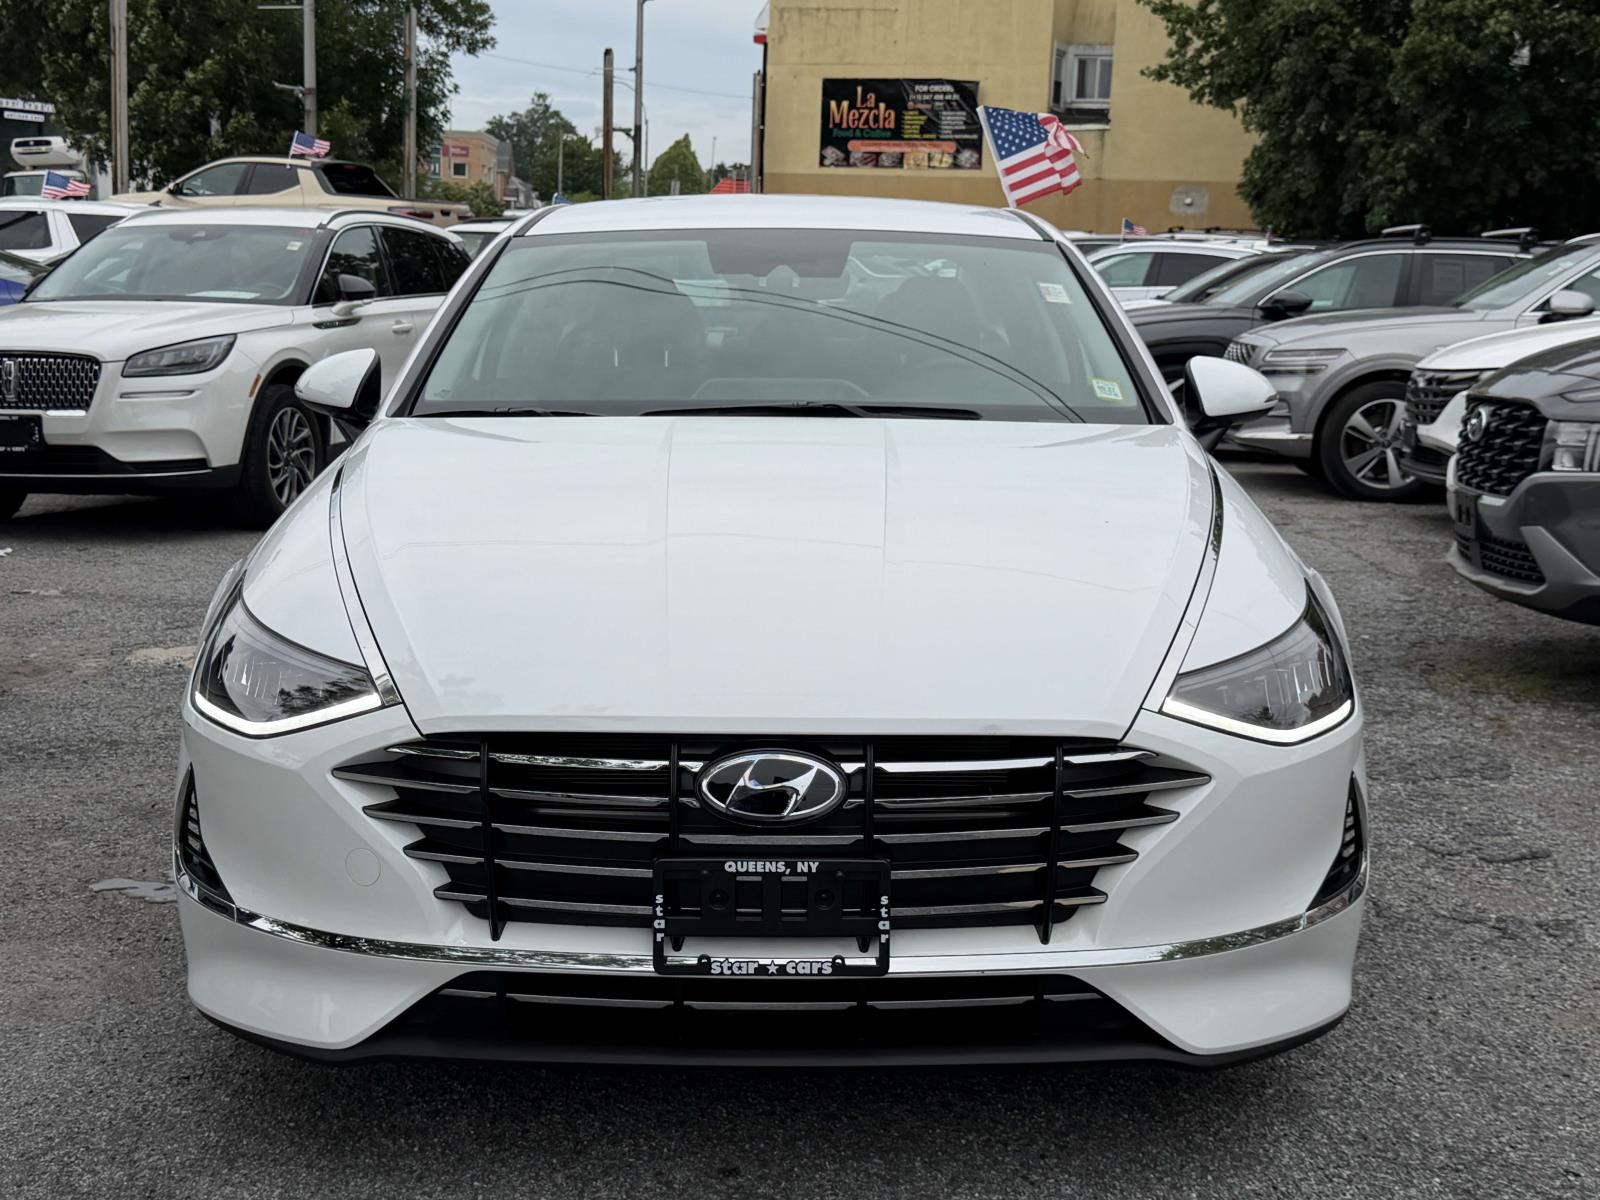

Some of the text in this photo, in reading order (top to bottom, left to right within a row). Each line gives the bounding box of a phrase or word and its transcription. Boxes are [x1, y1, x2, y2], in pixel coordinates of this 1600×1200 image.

[856, 85, 876, 108] La
[829, 100, 896, 129] Mezcla
[833, 128, 854, 138] Food
[854, 129, 862, 138] &
[724, 861, 819, 875] QUEENS, NY
[653, 894, 666, 942] star
[877, 895, 890, 943] star
[710, 958, 833, 975] star cars
